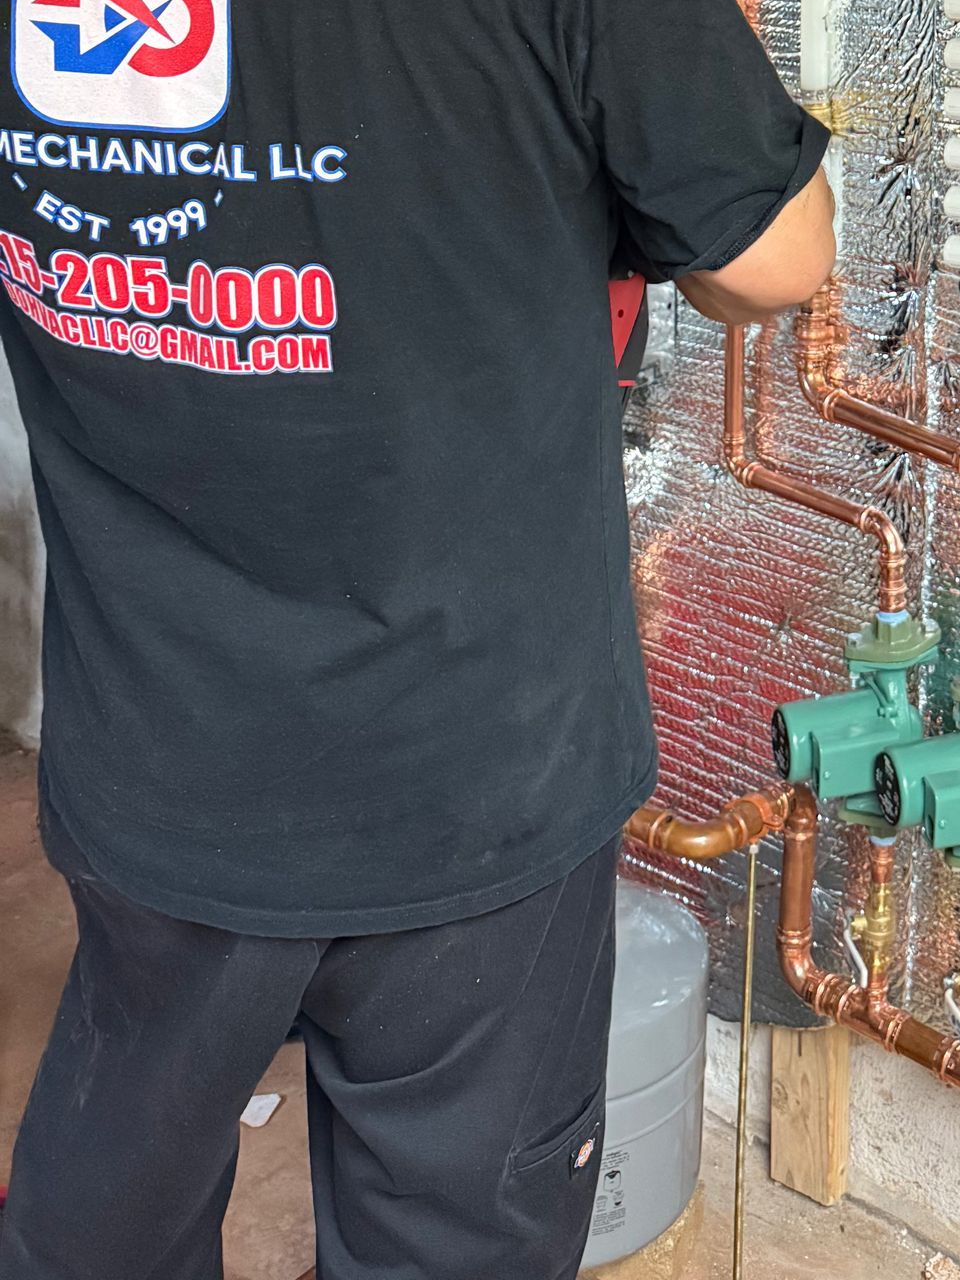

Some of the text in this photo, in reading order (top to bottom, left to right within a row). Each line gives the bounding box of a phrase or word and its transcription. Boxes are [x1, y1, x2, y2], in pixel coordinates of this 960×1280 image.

[268, 143, 348, 183] LLC
[33, 189, 208, 247] EST 1999
